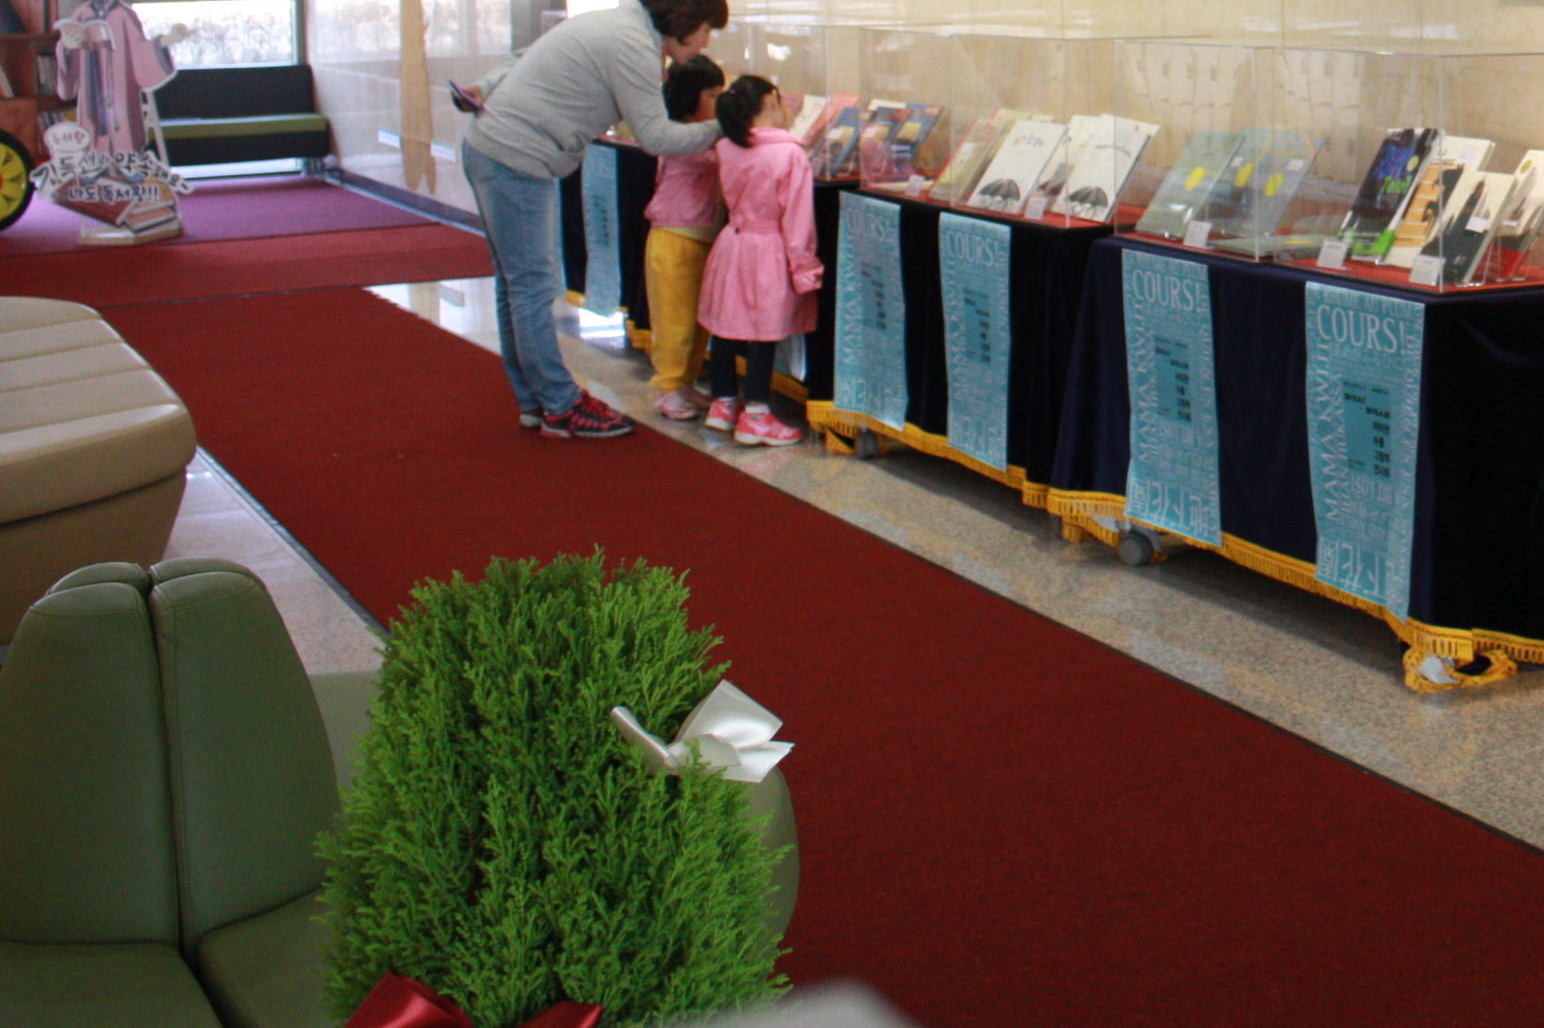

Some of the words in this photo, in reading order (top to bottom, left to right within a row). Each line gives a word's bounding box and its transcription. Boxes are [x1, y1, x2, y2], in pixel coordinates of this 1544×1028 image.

[1132, 268, 1200, 313] COURS!
[1317, 303, 1405, 357] COURS!
[1320, 432, 1338, 521] MAMA
